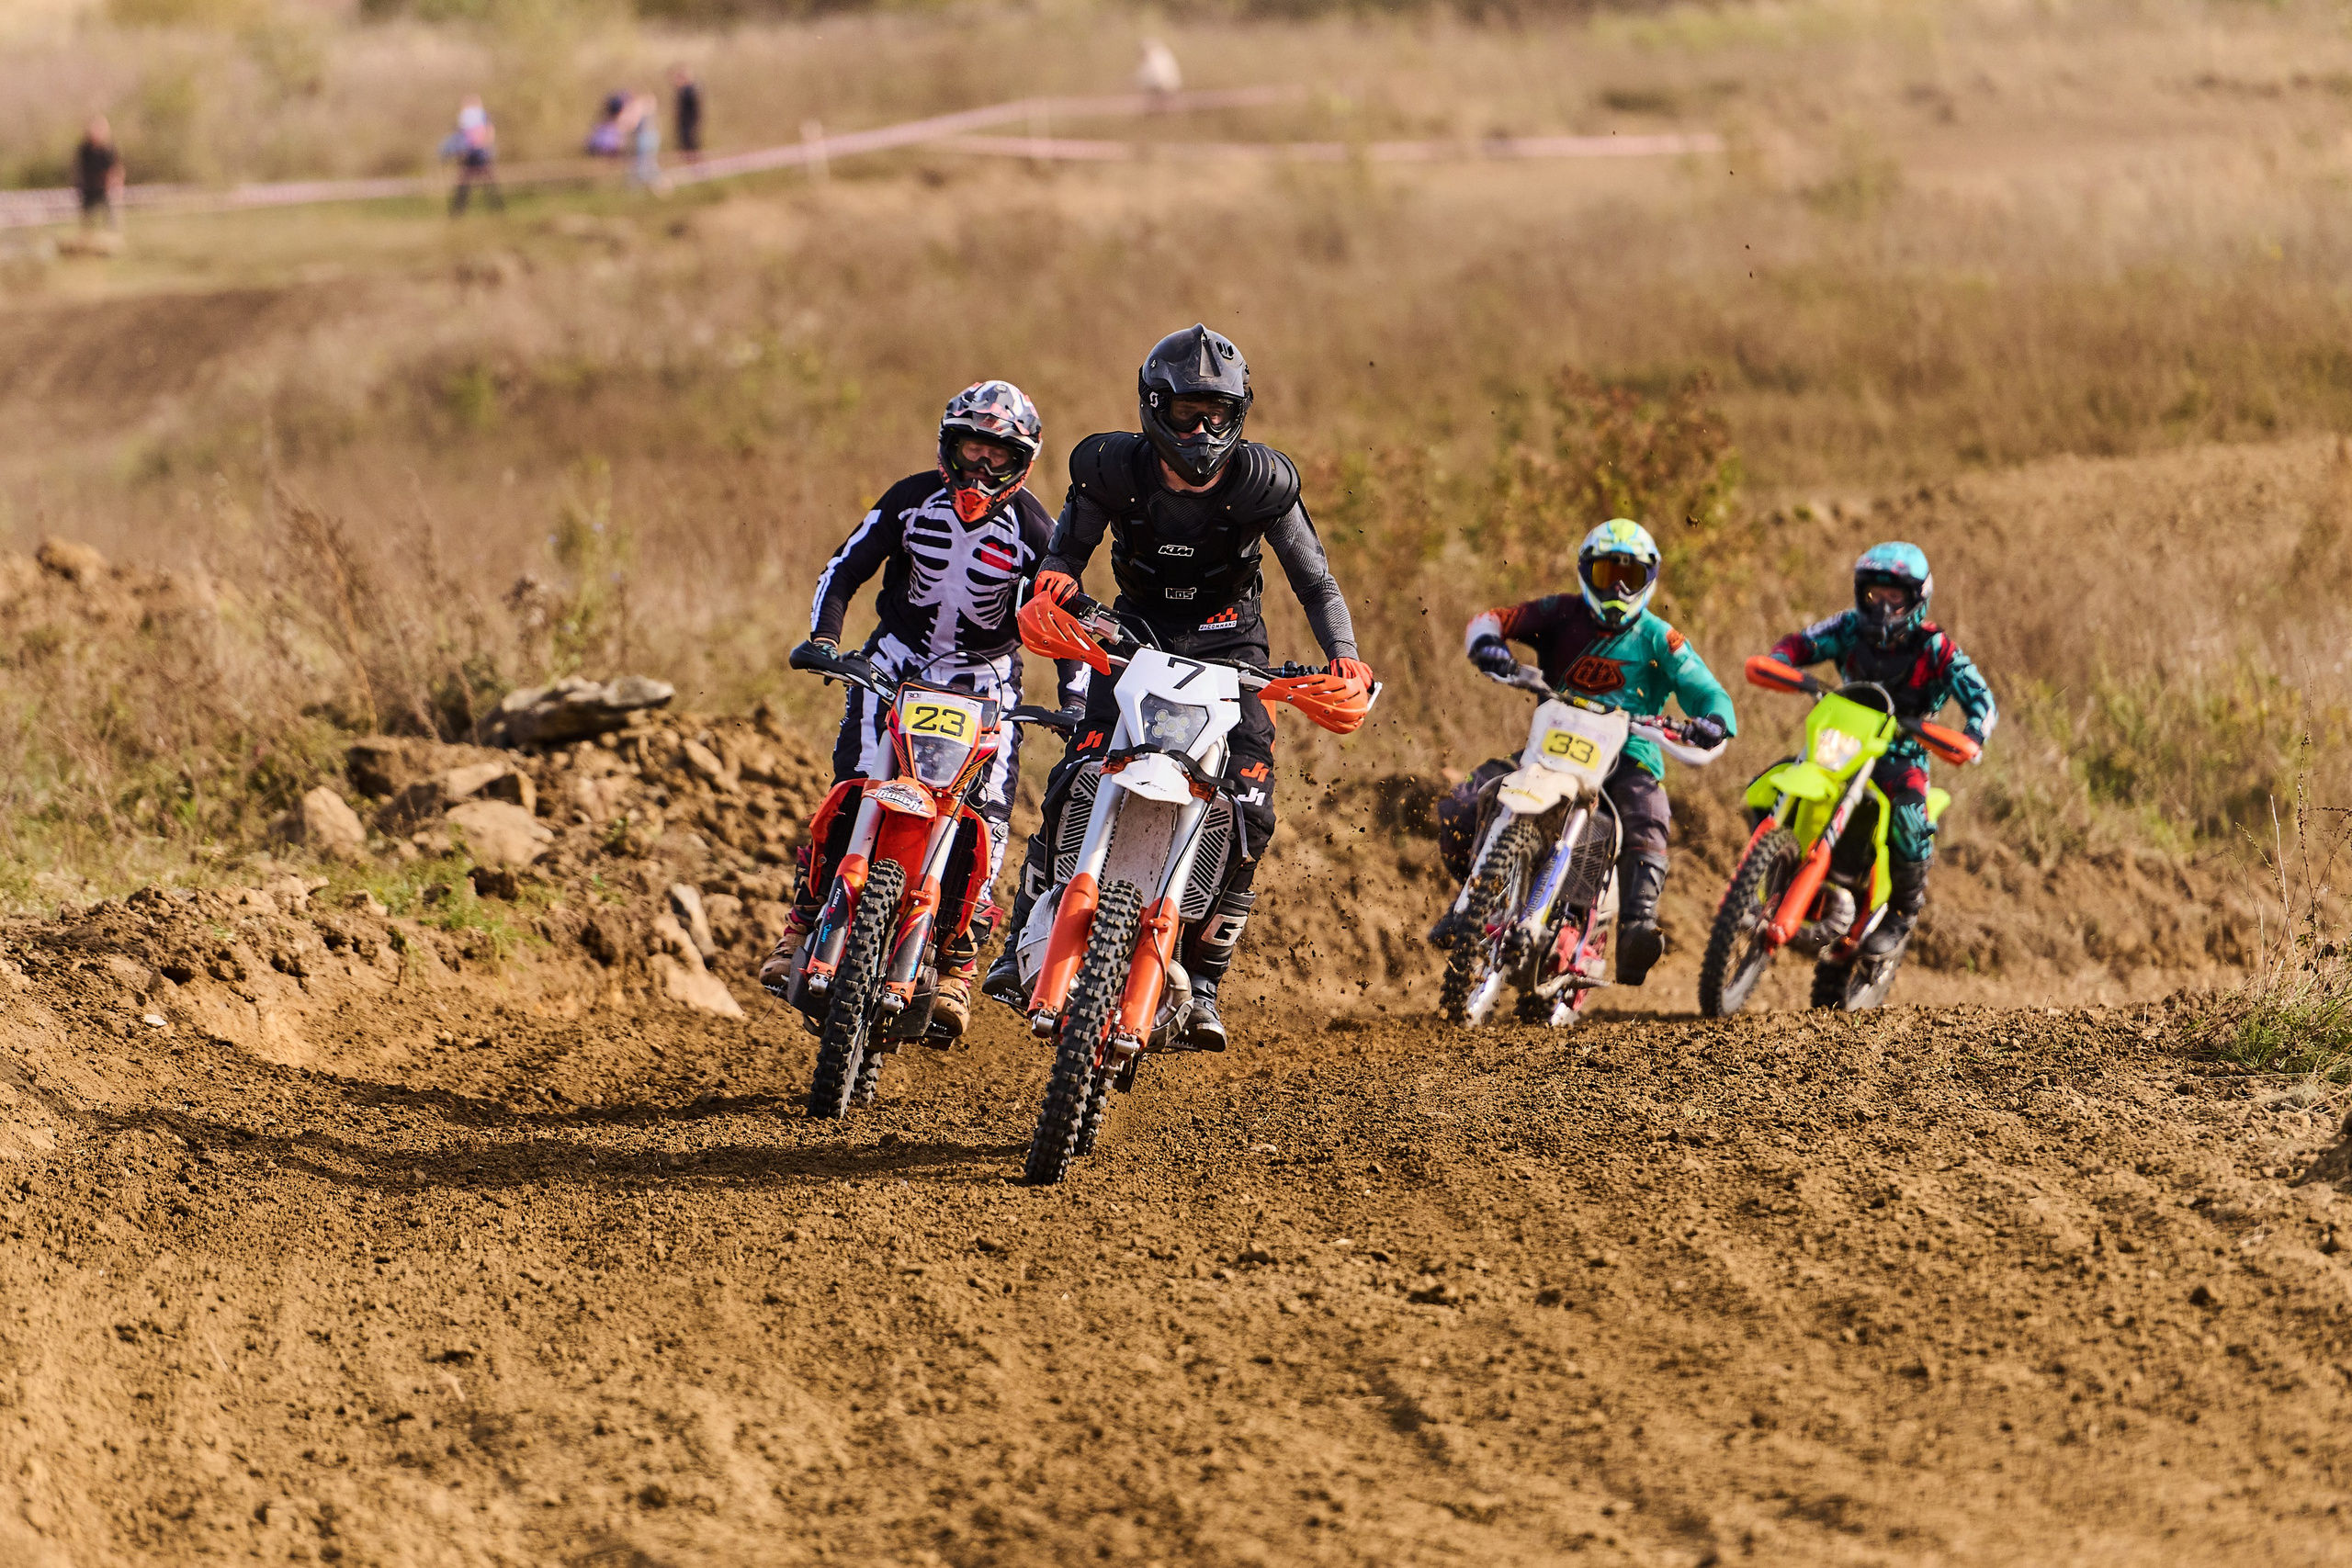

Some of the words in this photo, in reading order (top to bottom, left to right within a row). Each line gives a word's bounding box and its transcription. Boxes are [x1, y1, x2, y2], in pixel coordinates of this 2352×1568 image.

[1158, 544, 1194, 558] KTM
[1167, 657, 1205, 690] 7
[912, 706, 966, 737] 23
[1549, 732, 1594, 763] 33
